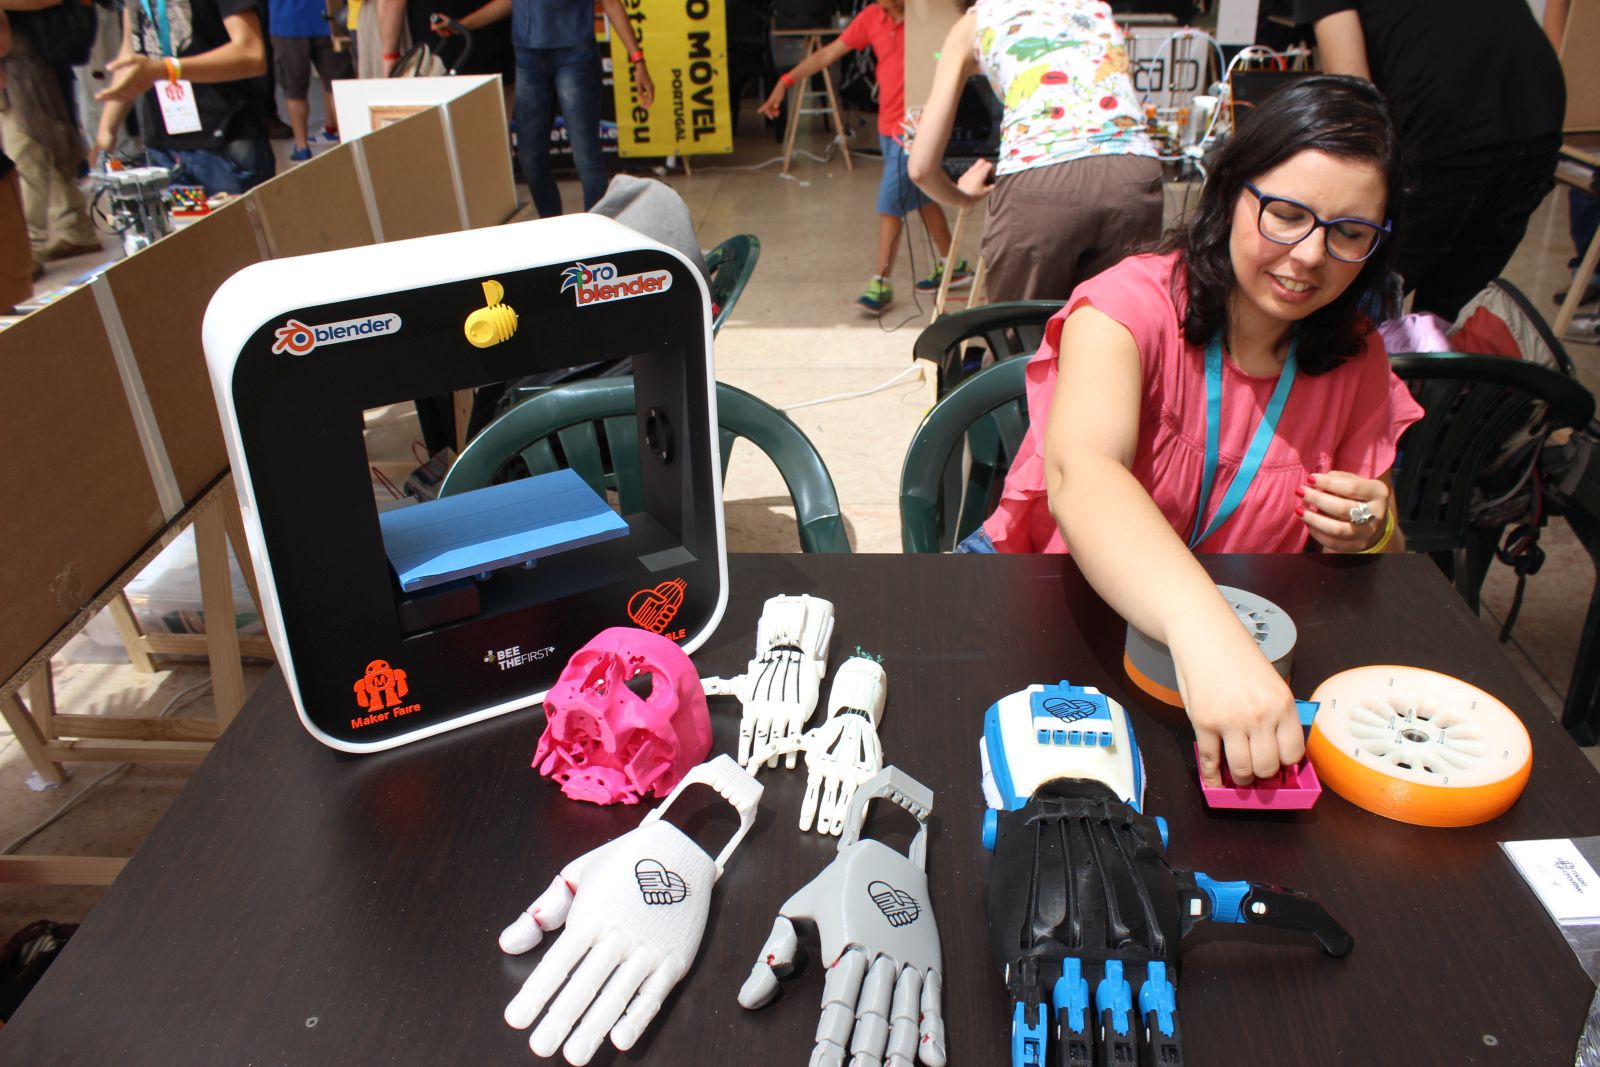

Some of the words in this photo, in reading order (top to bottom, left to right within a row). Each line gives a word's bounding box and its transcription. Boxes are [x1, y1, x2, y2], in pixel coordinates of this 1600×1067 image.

[687, 31, 718, 142] MÓVEL
[672, 68, 686, 143] PORTUGAL
[577, 275, 667, 304] blender
[314, 318, 393, 342] blender
[496, 645, 521, 661] BEE
[351, 711, 390, 729] Maker
[393, 703, 421, 717] Faire
